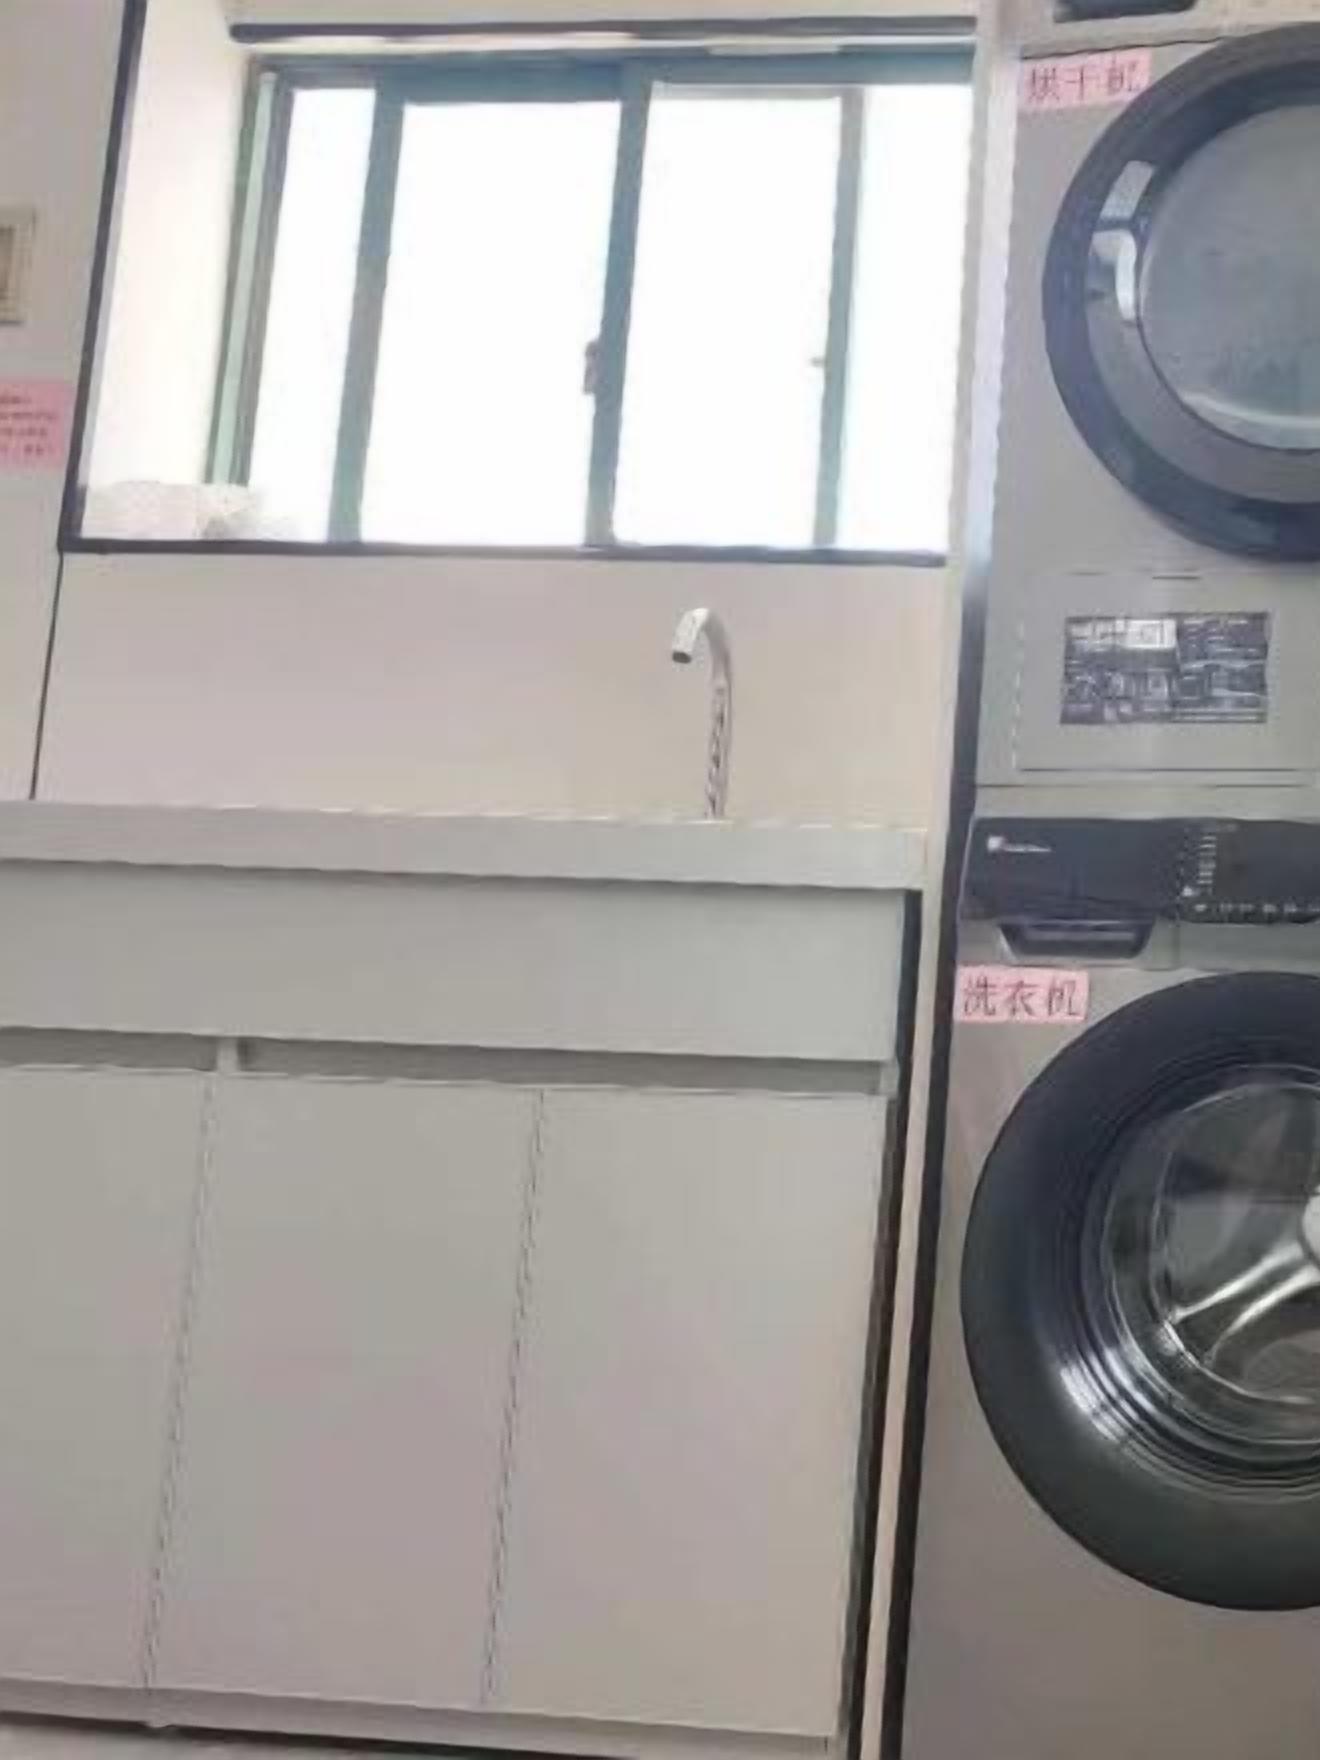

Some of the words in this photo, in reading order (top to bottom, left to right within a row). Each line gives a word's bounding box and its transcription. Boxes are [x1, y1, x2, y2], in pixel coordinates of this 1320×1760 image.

[1027, 54, 1142, 104] 烘干机
[963, 974, 1081, 1017] 洗衣机
